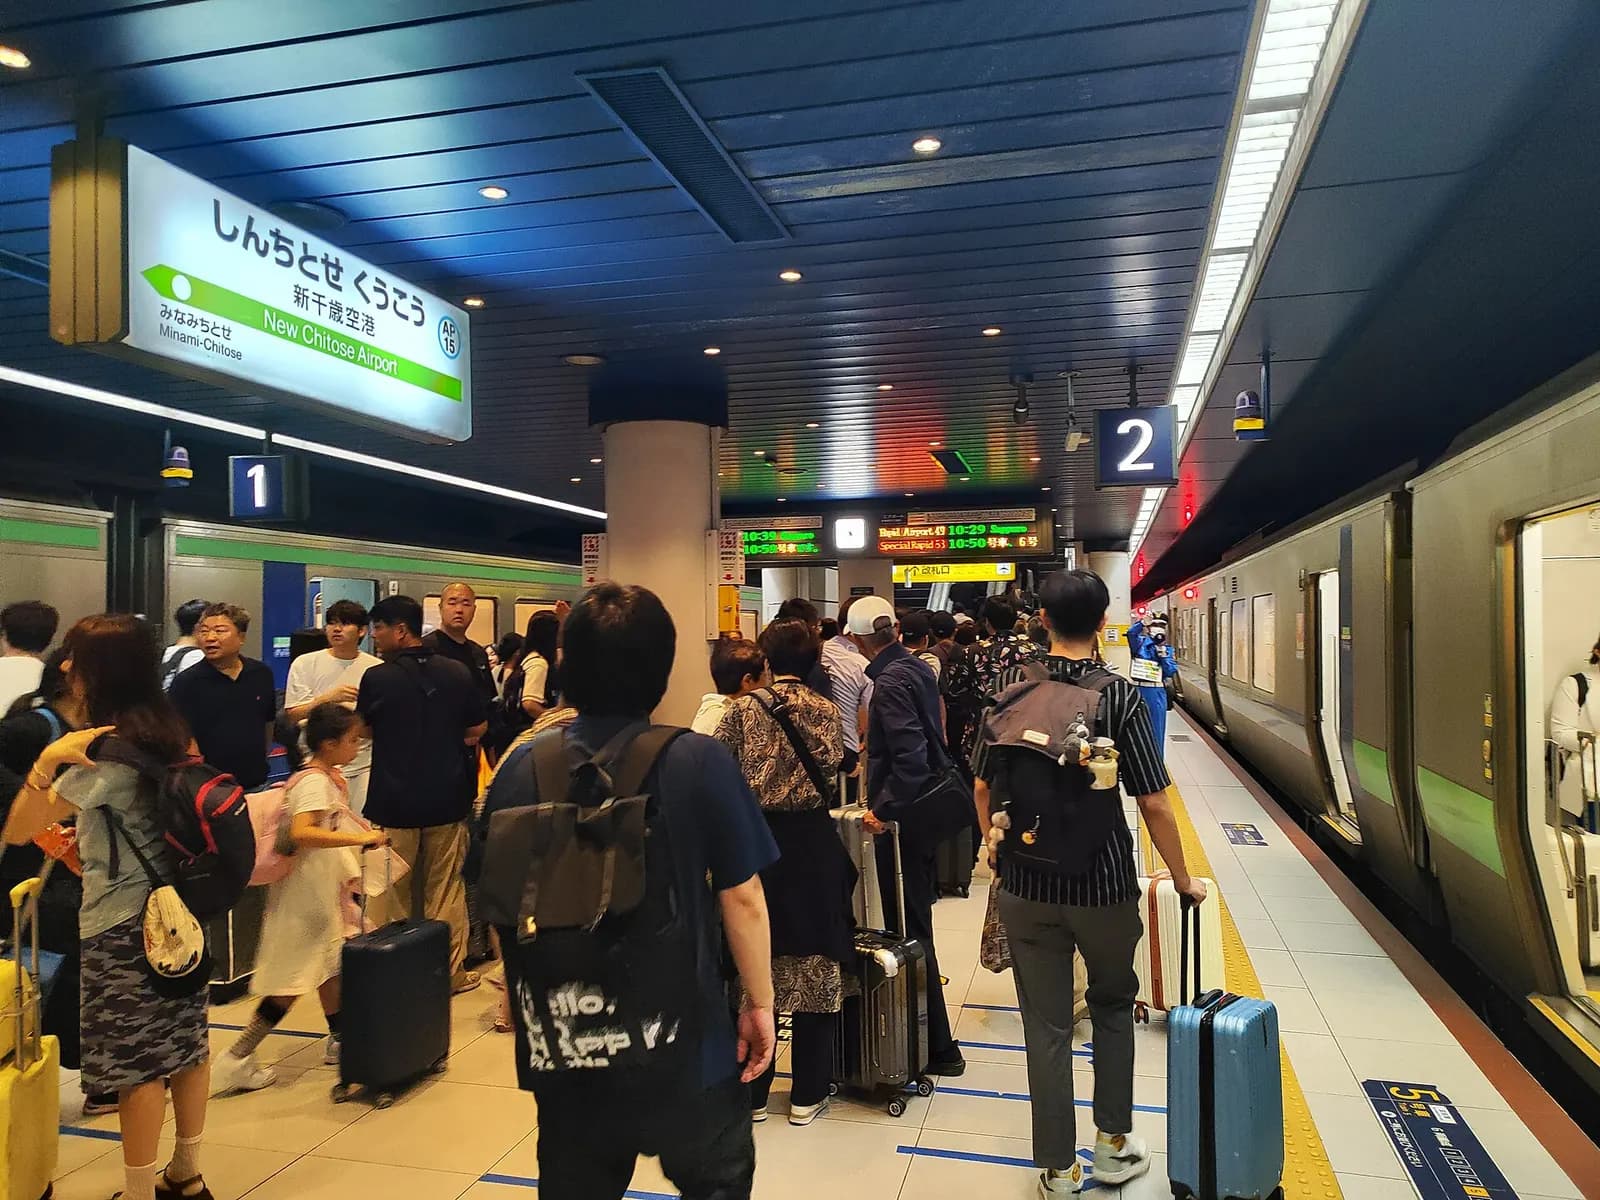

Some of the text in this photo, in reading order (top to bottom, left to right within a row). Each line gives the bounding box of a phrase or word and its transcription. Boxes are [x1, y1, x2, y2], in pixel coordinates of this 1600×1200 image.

[213, 199, 426, 327] しんちとせ くうこう
[159, 303, 232, 341] みなみちとせ
[294, 284, 375, 337] 新千歳空港
[443, 320, 456, 337] AP
[159, 323, 243, 361] Minami-Chitose
[264, 309, 398, 375] New Chitose Airport
[444, 336, 456, 354] 15
[1117, 418, 1154, 472] 2
[247, 464, 267, 508] 1
[742, 530, 777, 541] 10:39
[880, 540, 910, 551] Special
[911, 540, 934, 551] Rapid
[948, 538, 987, 549] 10:50
[903, 526, 934, 537] Airport
[948, 525, 986, 536] 10:29
[1389, 1086, 1441, 1102] 5
